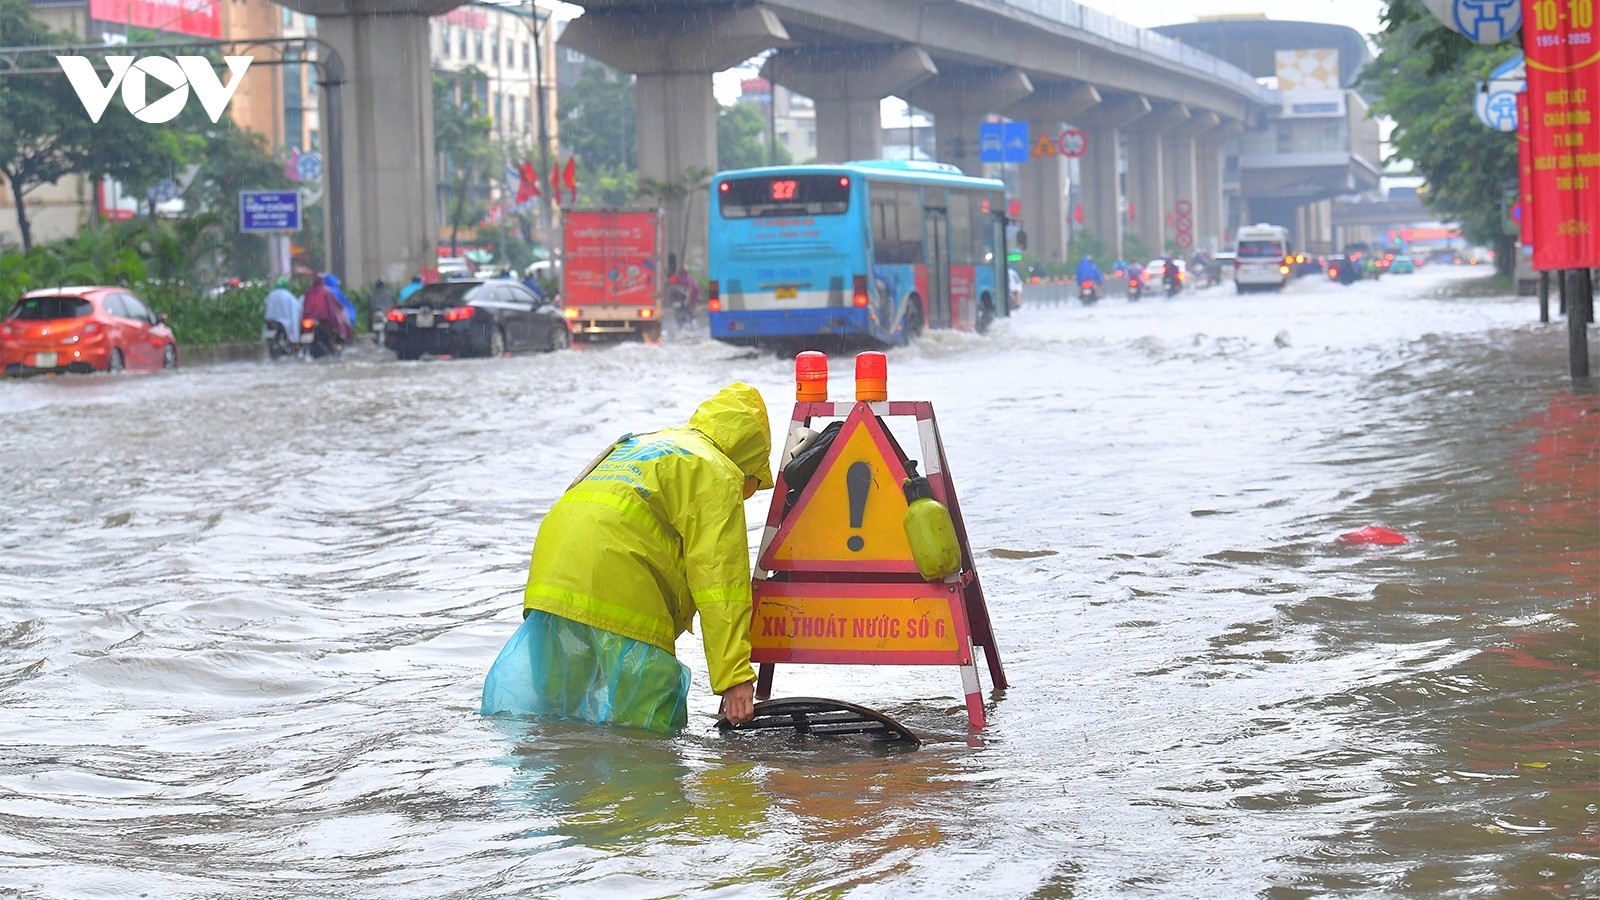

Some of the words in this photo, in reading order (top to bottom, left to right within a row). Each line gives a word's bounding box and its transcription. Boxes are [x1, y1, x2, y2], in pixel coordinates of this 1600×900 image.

[1537, 35, 1559, 47] 1954
[1568, 32, 1591, 45] 2025
[1543, 110, 1565, 127] CHÀO
[772, 180, 797, 199] 27
[762, 616, 786, 637] XN
[792, 613, 847, 638] THOÁT
[852, 613, 899, 638] NƯỚC
[906, 611, 930, 638] SỐ
[935, 618, 945, 638] 6
